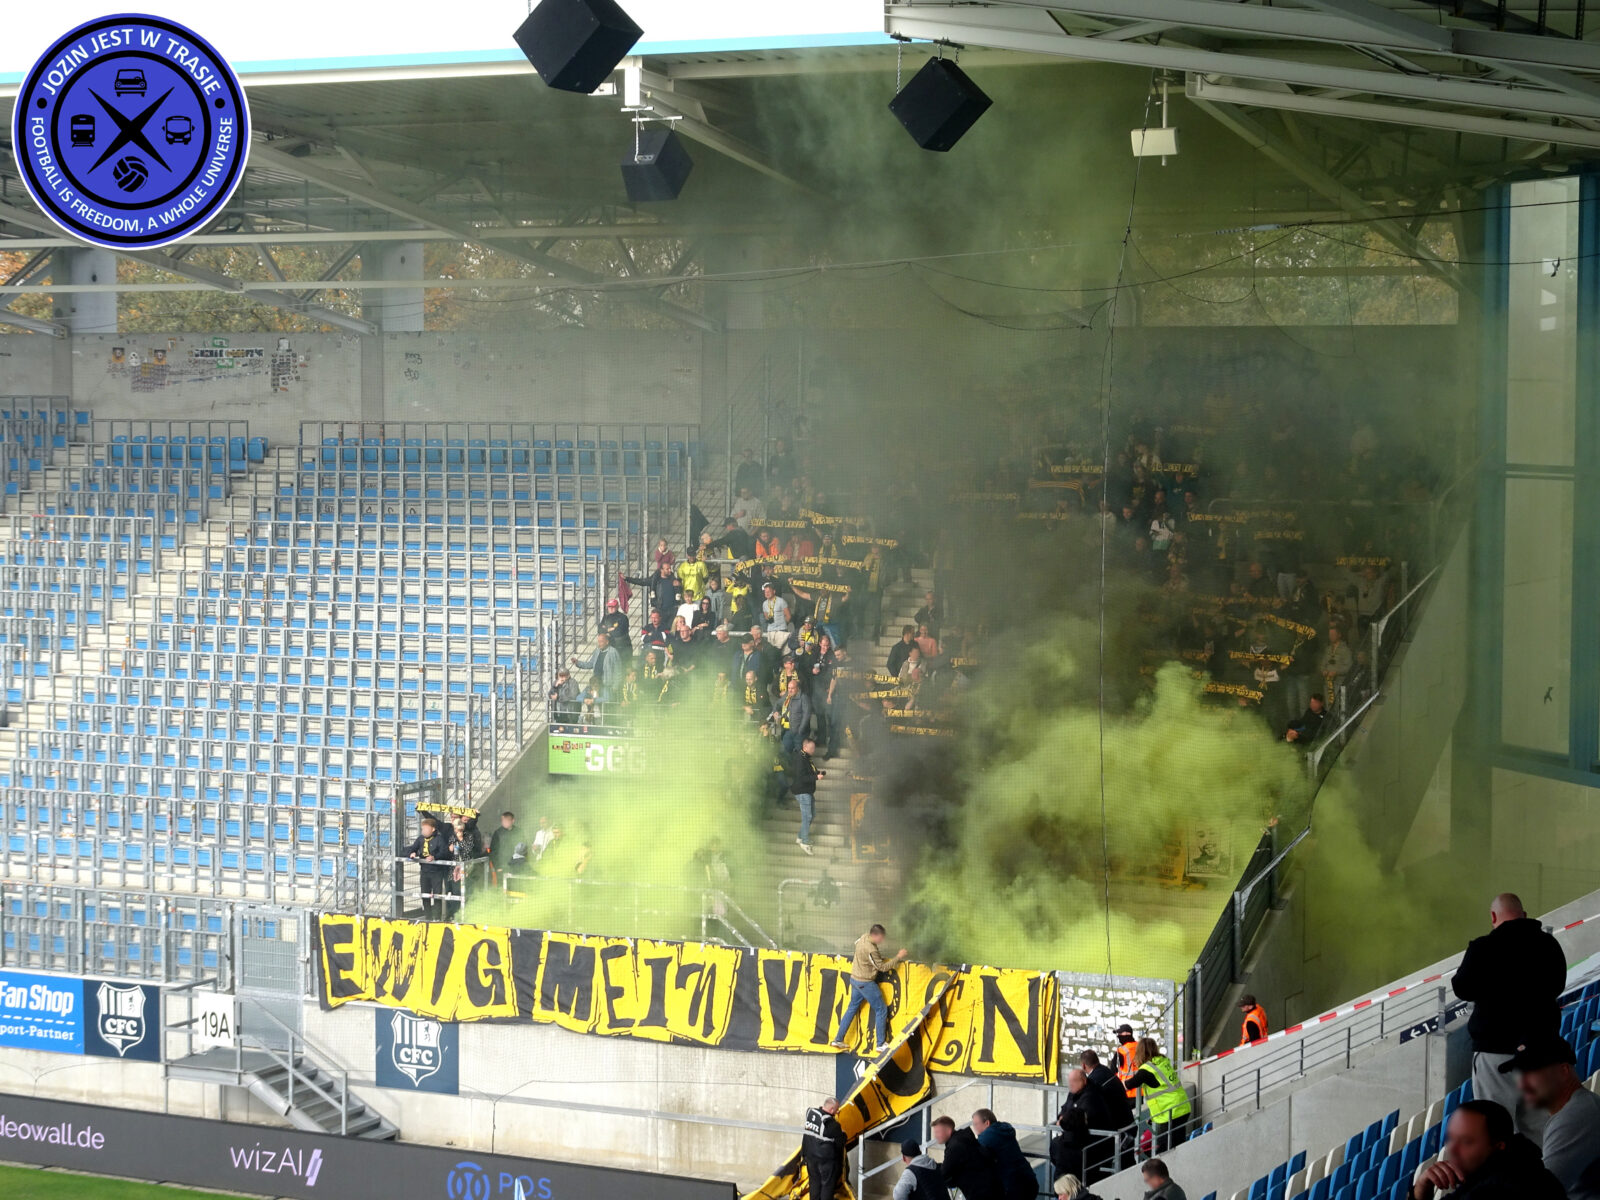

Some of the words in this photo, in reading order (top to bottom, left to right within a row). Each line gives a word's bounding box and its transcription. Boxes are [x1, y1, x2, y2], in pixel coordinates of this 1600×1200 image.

[0, 981, 28, 1009] Fan
[29, 984, 74, 1017] Shop
[105, 1017, 138, 1035] CFC
[201, 1011, 231, 1040] 19A
[400, 1047, 433, 1067] CFC
[499, 1172, 555, 1200] PO.S.
